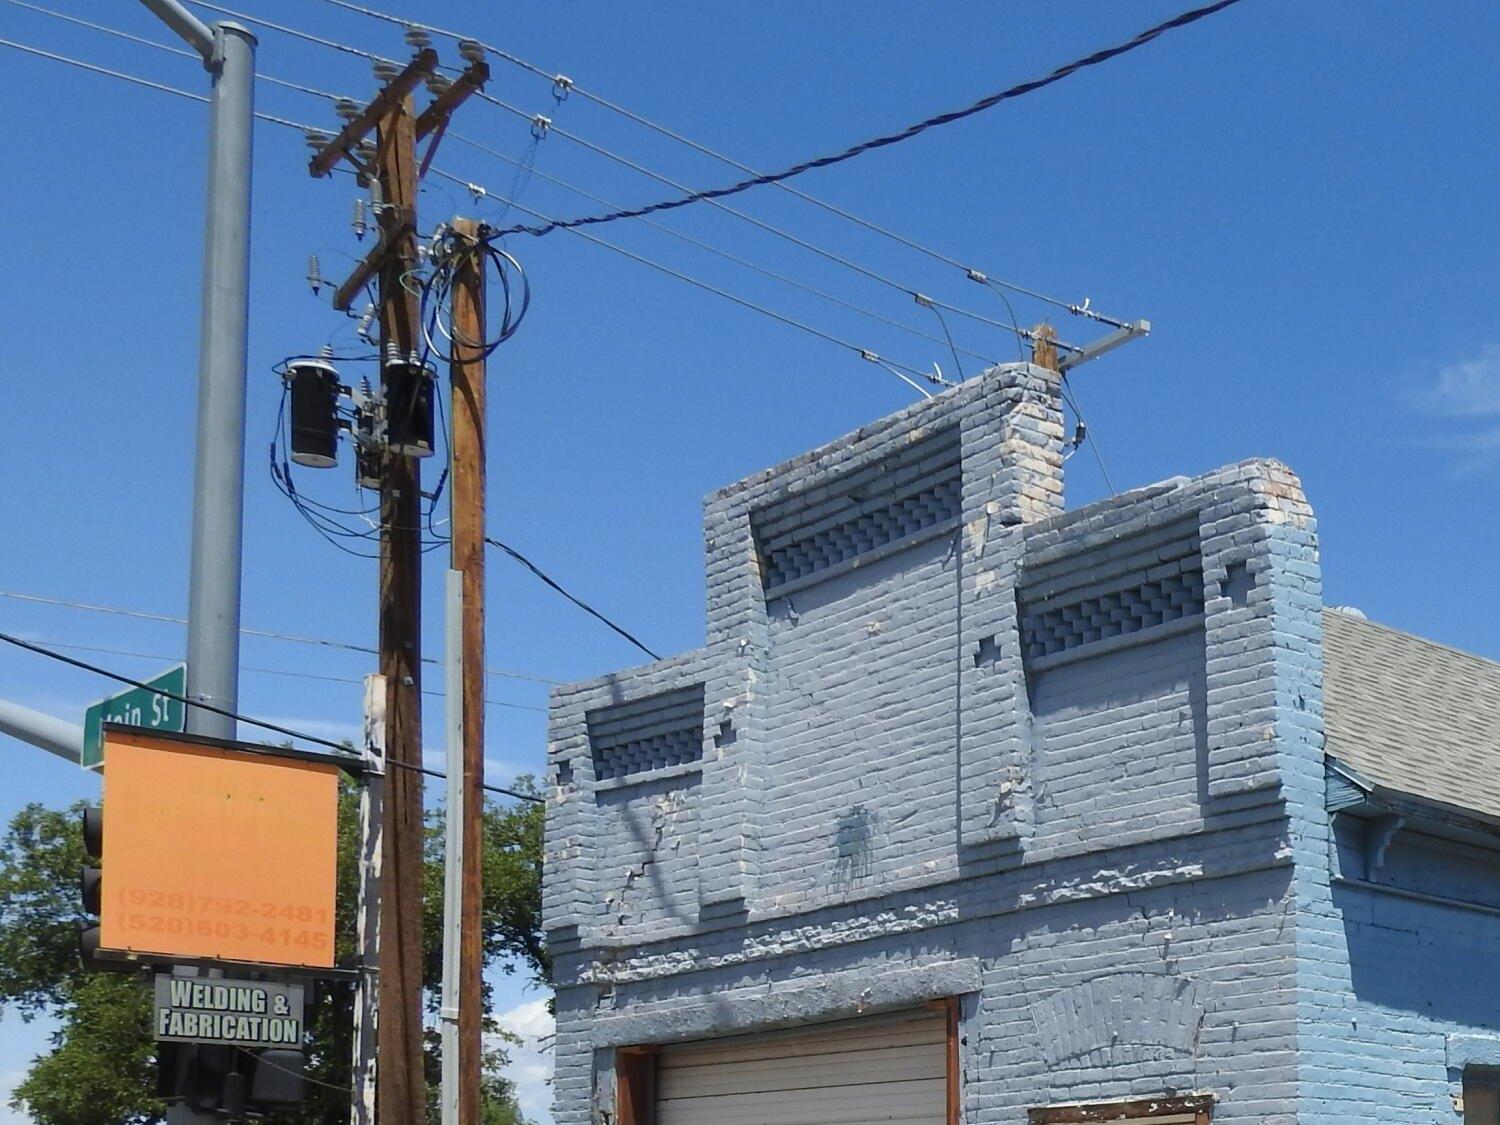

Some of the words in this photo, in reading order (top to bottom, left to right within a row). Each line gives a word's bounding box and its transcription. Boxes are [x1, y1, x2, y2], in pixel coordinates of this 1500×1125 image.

[151, 689, 171, 726] St
[170, 980, 266, 1012] WELDING
[273, 994, 289, 1015] &
[158, 1008, 299, 1043] FABRICATION
